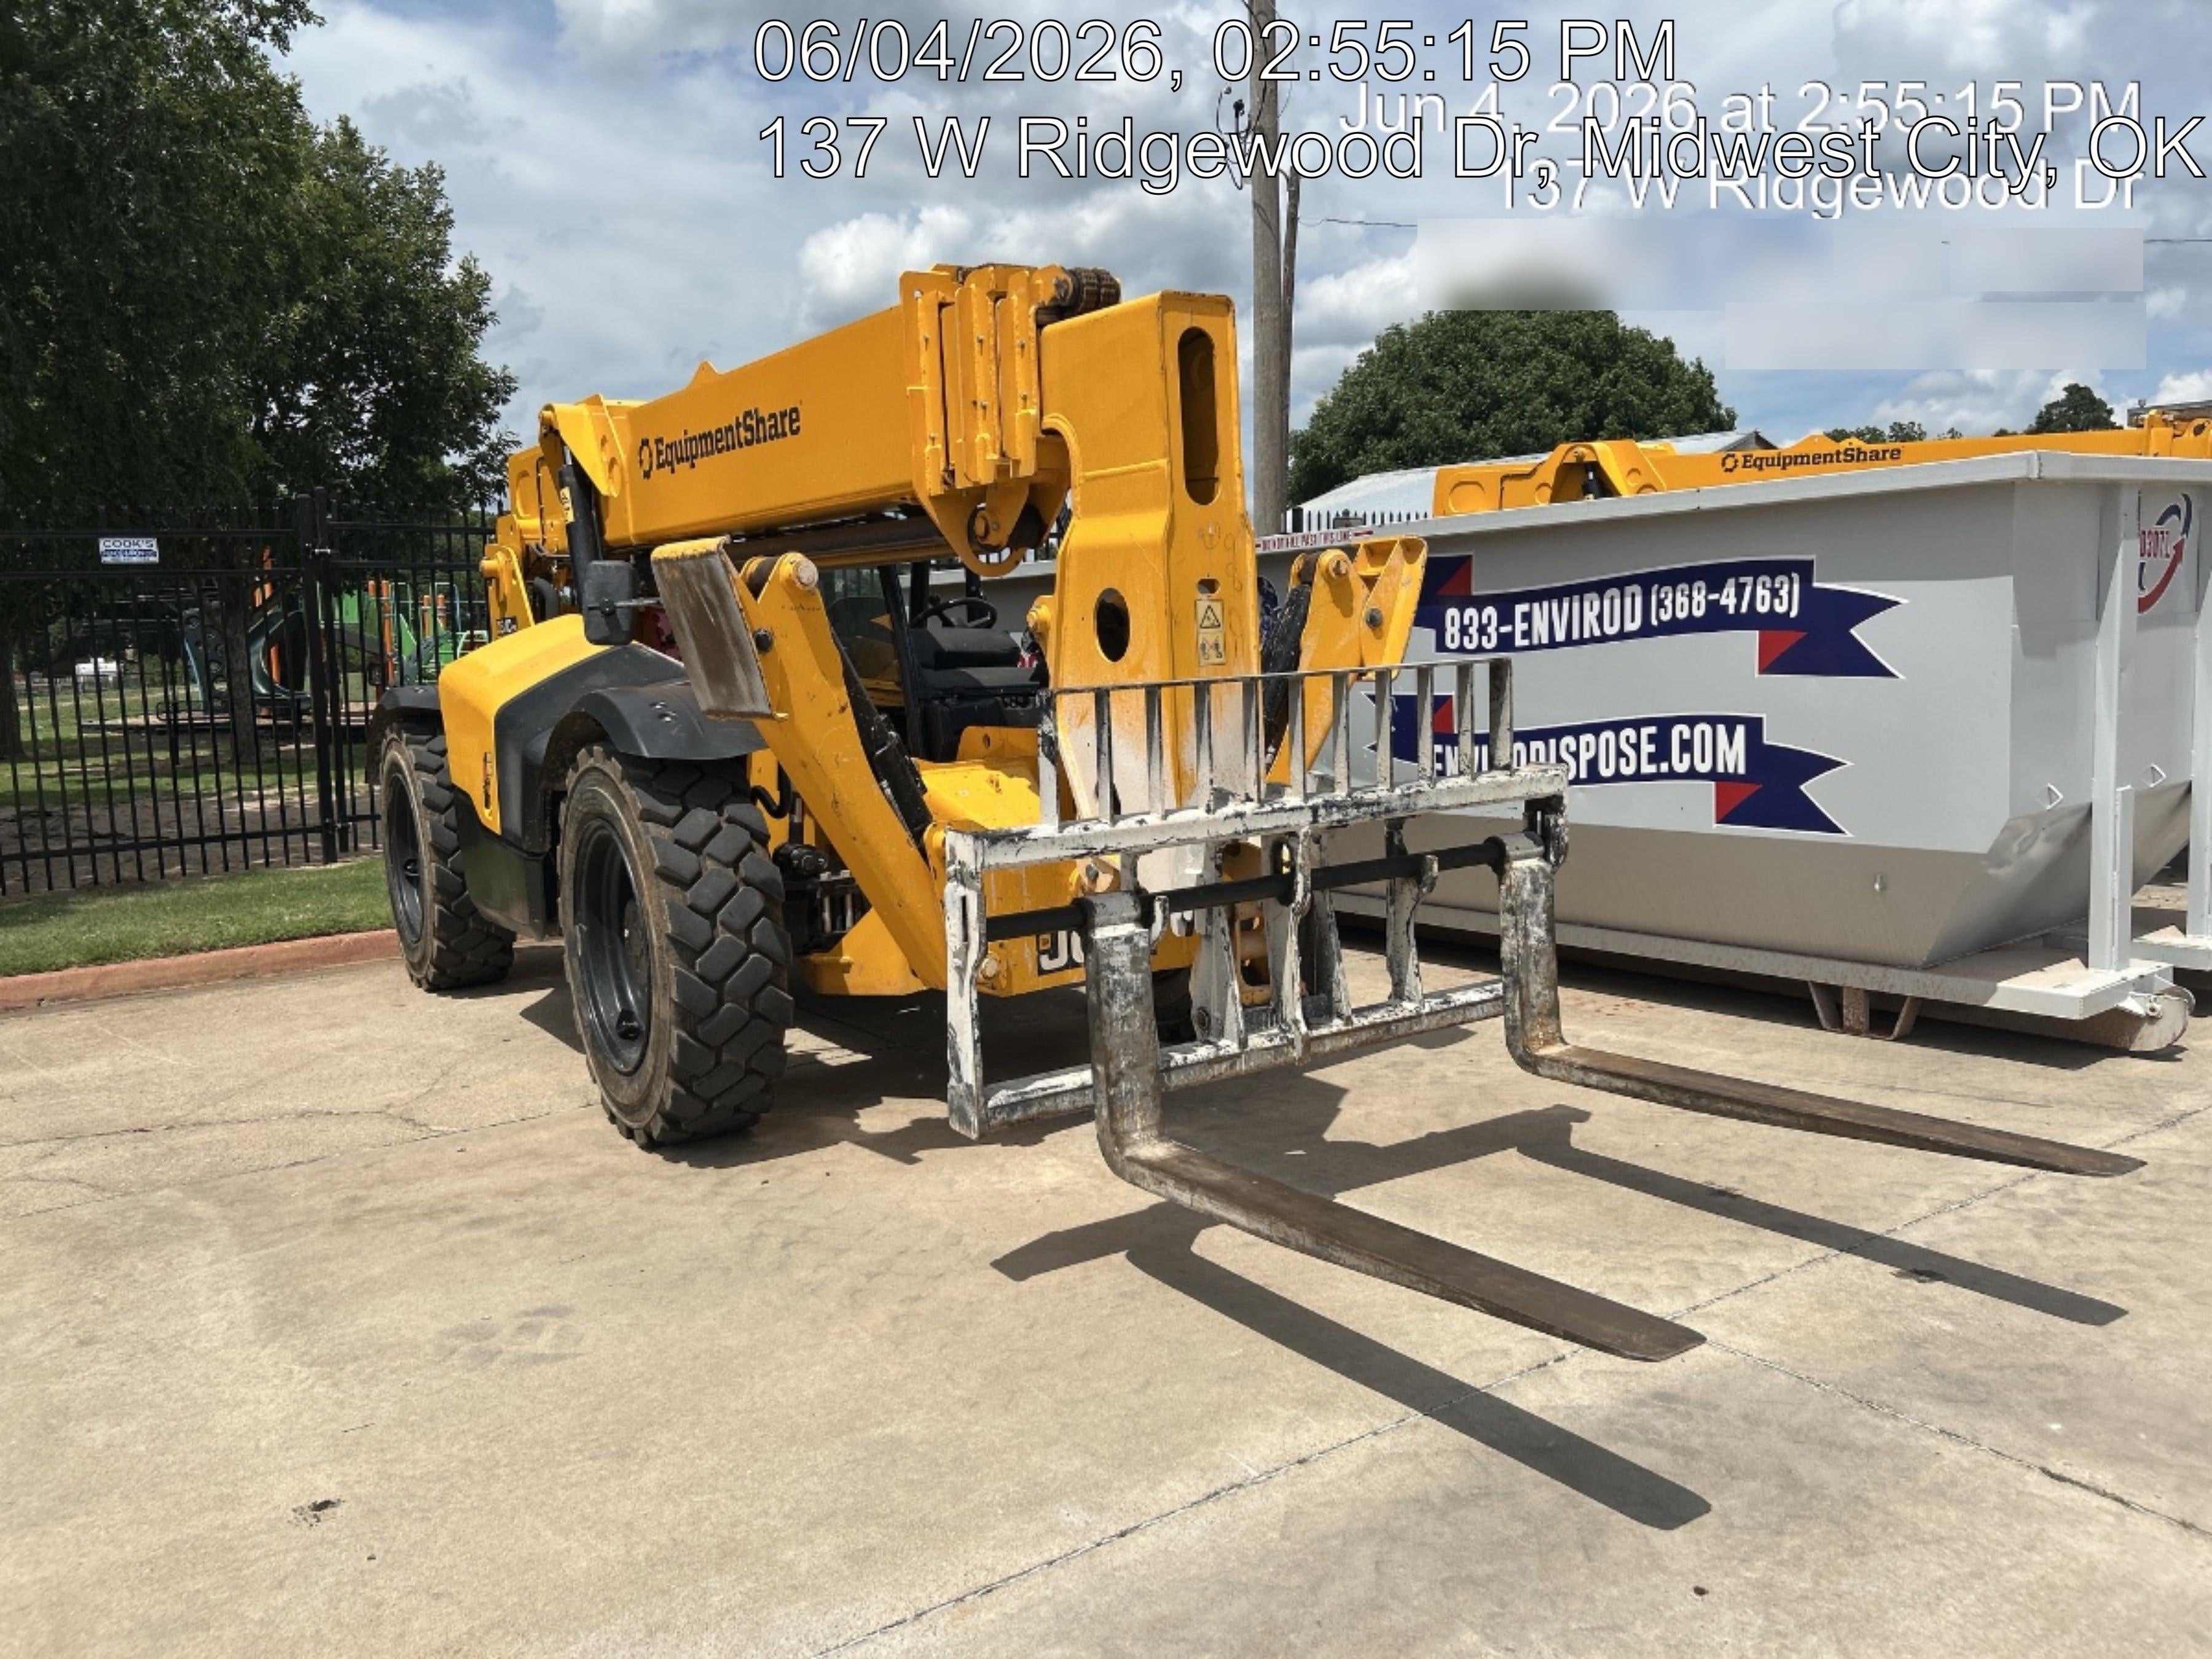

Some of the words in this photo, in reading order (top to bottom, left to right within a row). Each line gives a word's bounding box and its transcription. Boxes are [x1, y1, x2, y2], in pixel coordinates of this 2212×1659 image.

[654, 406, 801, 474] EquipmentShare
[1741, 447, 1902, 471] EquipmentShare
[103, 539, 154, 549] COOK'S
[1445, 584, 1642, 650] 833-ENVIROD
[1651, 572, 1800, 626] (368-4763)
[1433, 723, 1746, 780] ENIODISPOSE.COM
